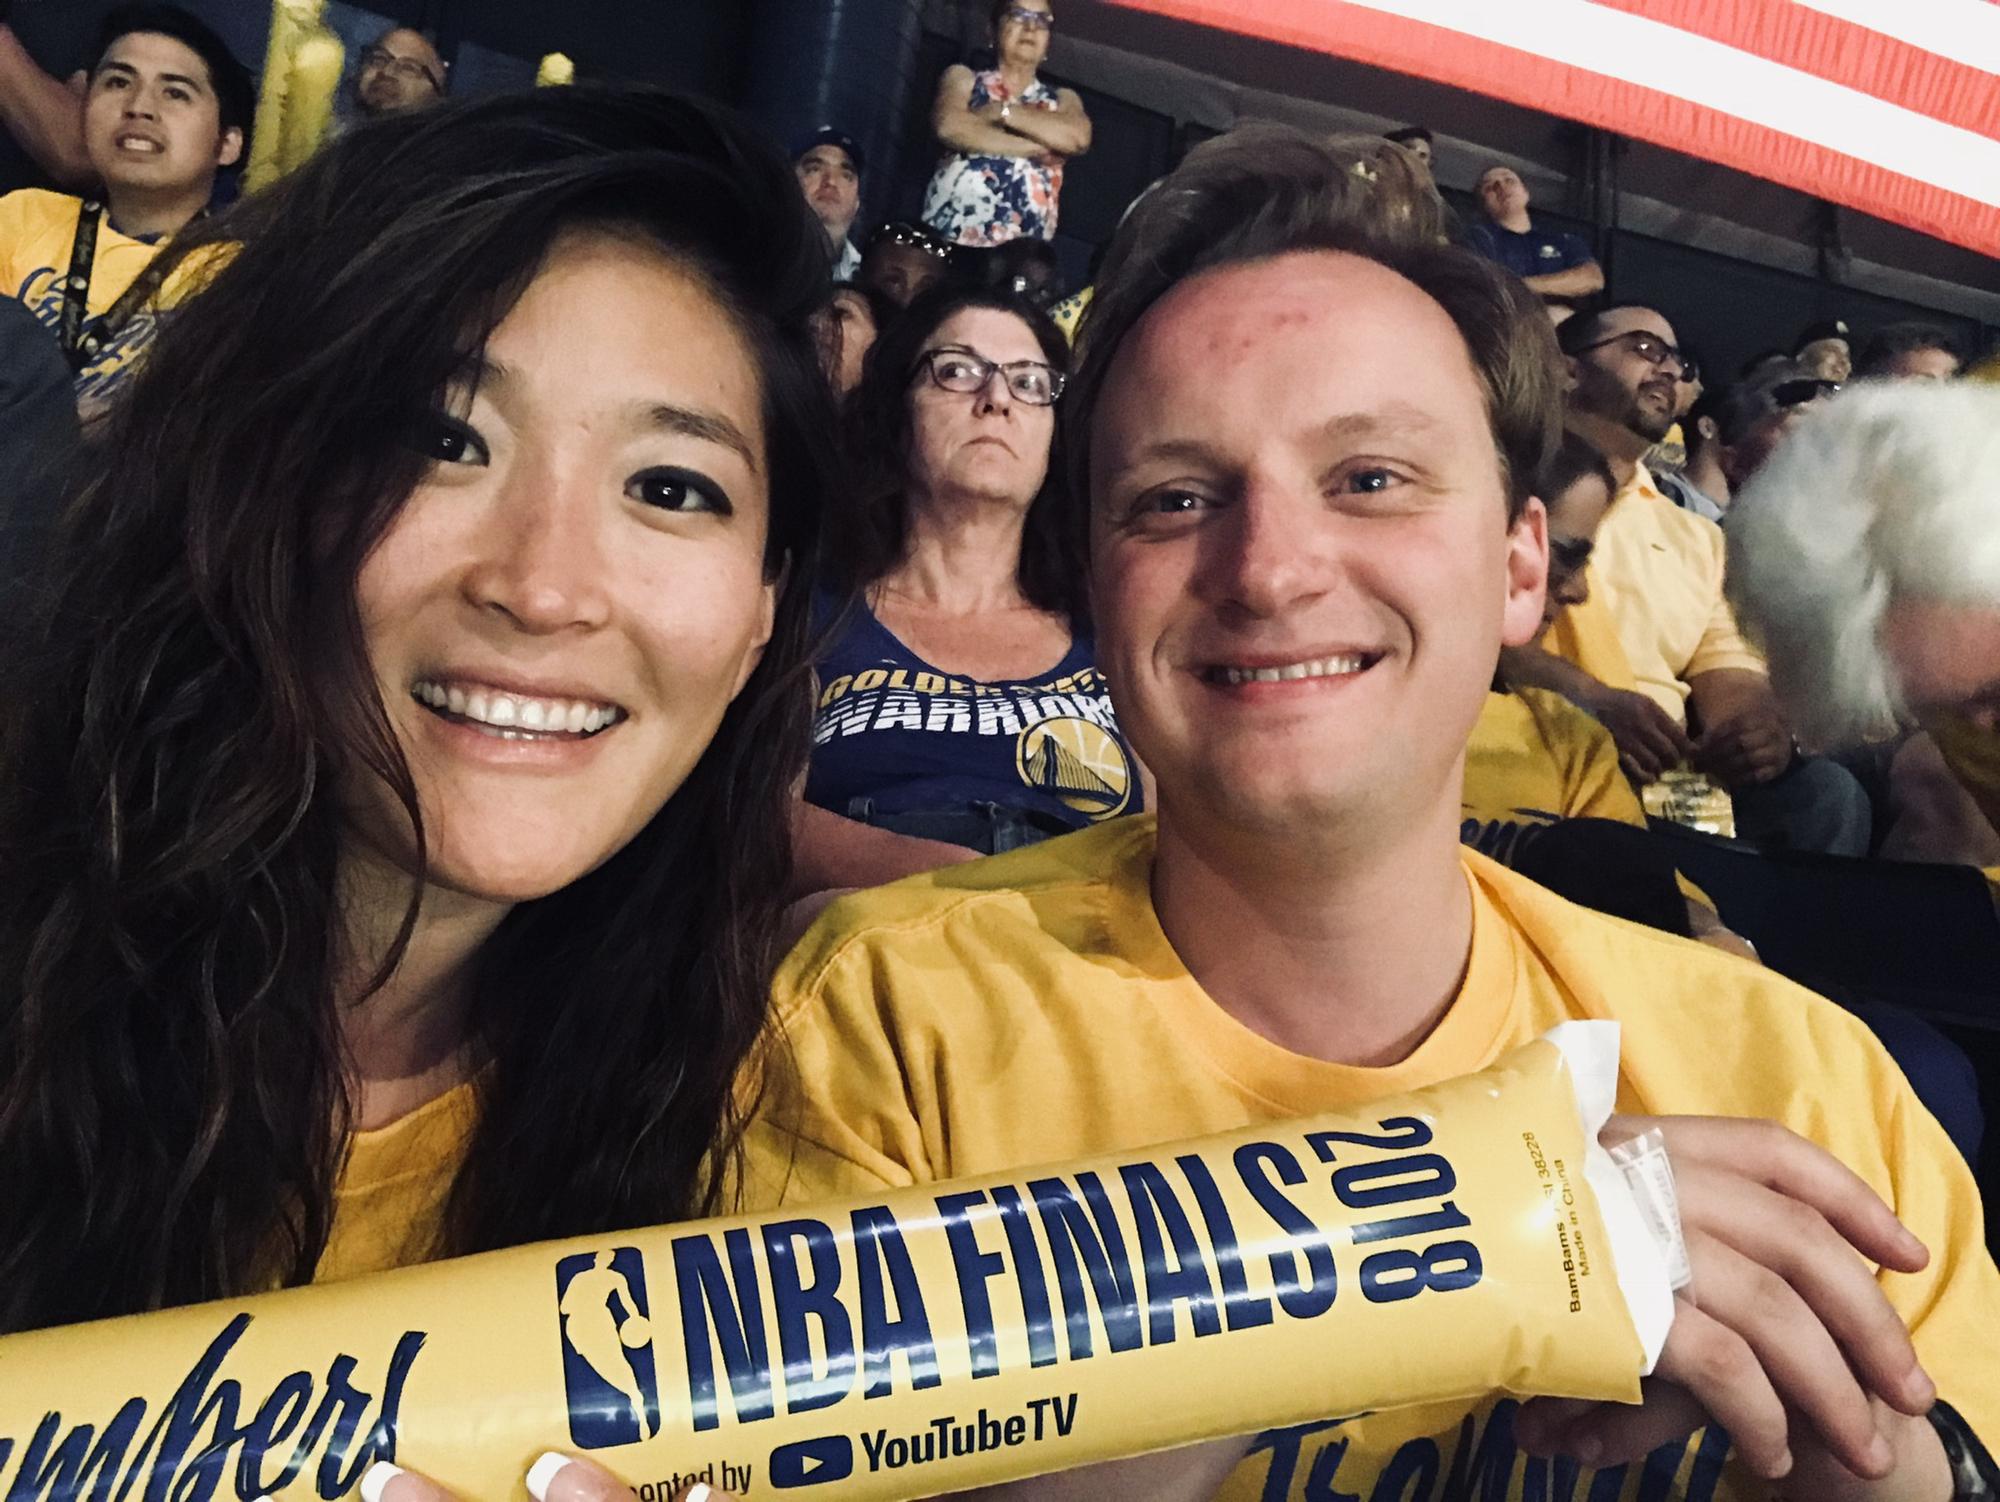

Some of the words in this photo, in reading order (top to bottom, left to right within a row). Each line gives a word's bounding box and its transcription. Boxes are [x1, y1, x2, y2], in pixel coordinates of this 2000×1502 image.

[1522, 1131, 1550, 1179] 38228
[1554, 1158, 1575, 1206] China
[1304, 1116, 1483, 1303] 2018
[1569, 1210, 1579, 1226] in
[1557, 1222, 1581, 1313] BamBams
[1573, 1230, 1591, 1277] Made
[671, 1205, 942, 1432] NBA
[935, 1141, 1338, 1380] FINALS
[721, 1459, 752, 1496] by
